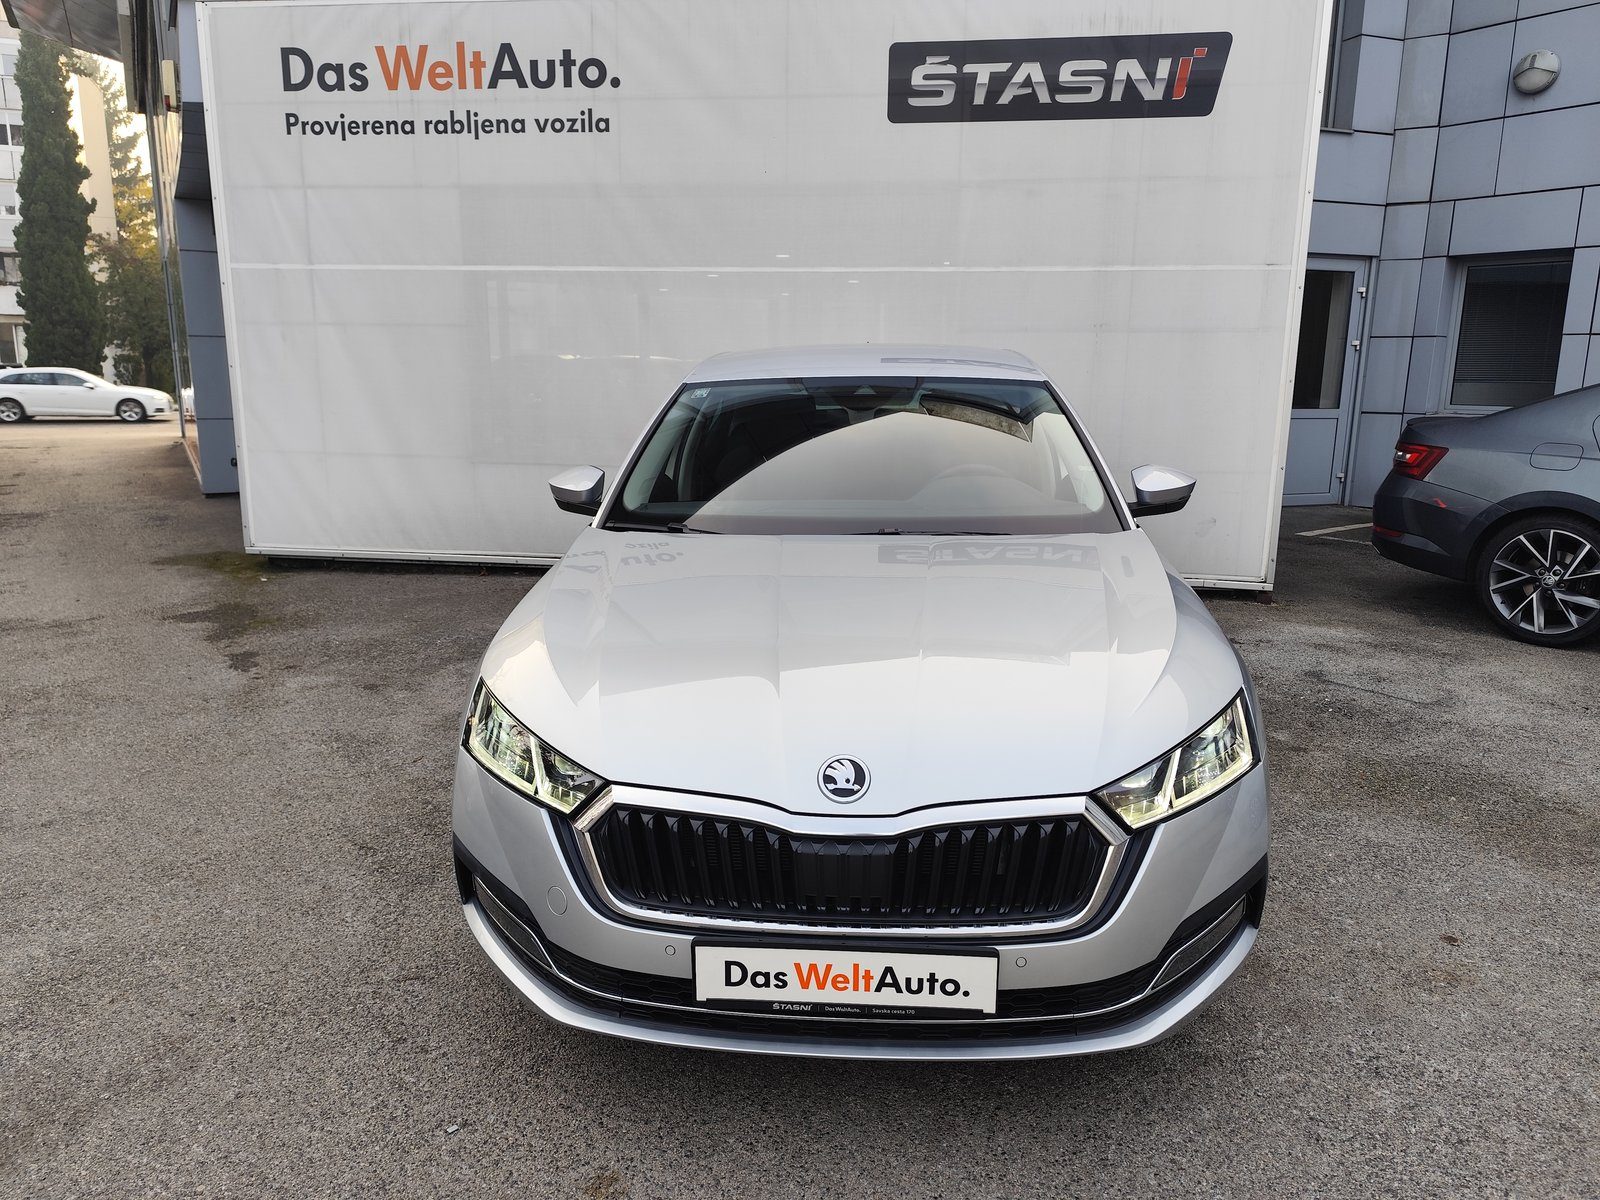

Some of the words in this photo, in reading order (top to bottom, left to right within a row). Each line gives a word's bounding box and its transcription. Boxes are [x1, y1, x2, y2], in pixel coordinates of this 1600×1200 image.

[280, 46, 369, 92] Das
[374, 41, 621, 91] WeltAuto.
[284, 112, 415, 141] Provjerena
[424, 109, 526, 140] rabljena
[534, 108, 610, 133] vozila
[724, 960, 788, 989] Das
[793, 962, 971, 998] WeltAuto.
